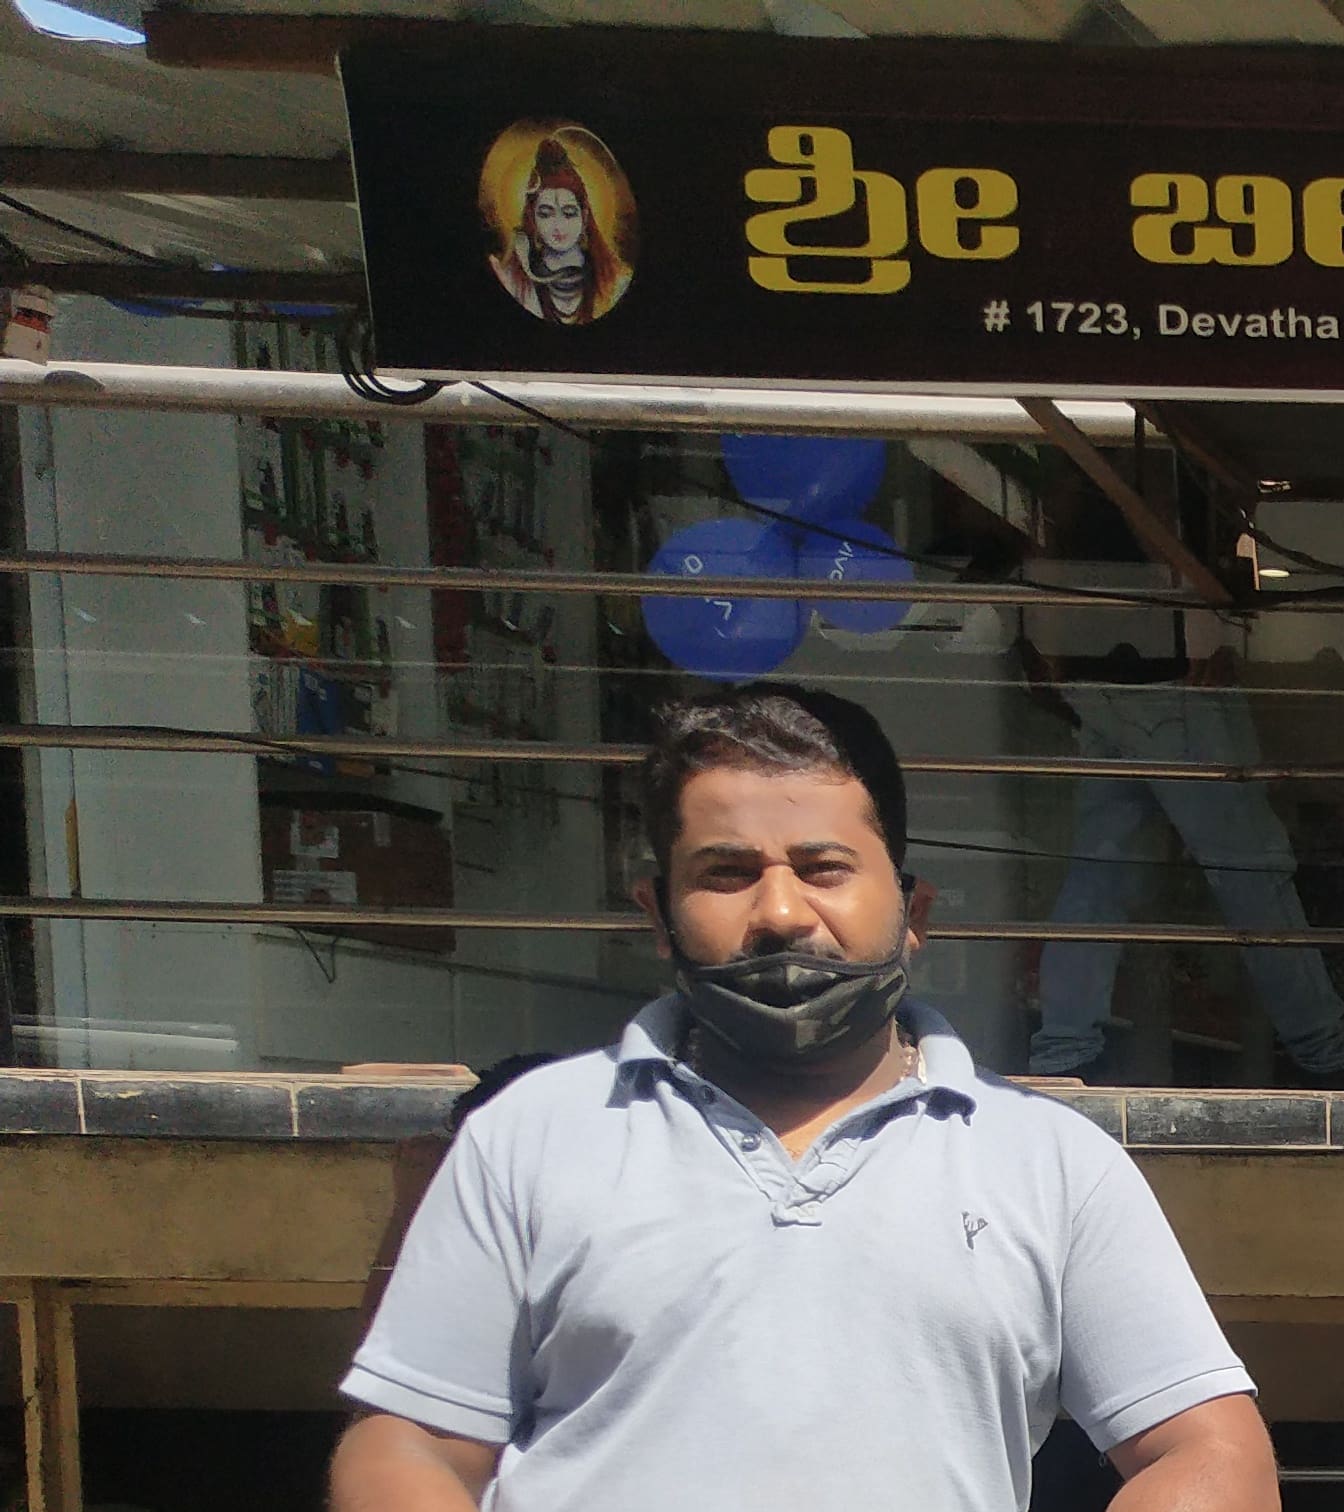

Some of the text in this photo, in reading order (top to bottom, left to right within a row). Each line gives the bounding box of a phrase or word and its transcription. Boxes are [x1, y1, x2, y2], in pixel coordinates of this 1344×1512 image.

[745, 126, 1019, 294] ಶ್ರೀ
[984, 301, 1010, 331] #
[1027, 302, 1140, 340] 1723,
[1159, 305, 1339, 338] Devatha
